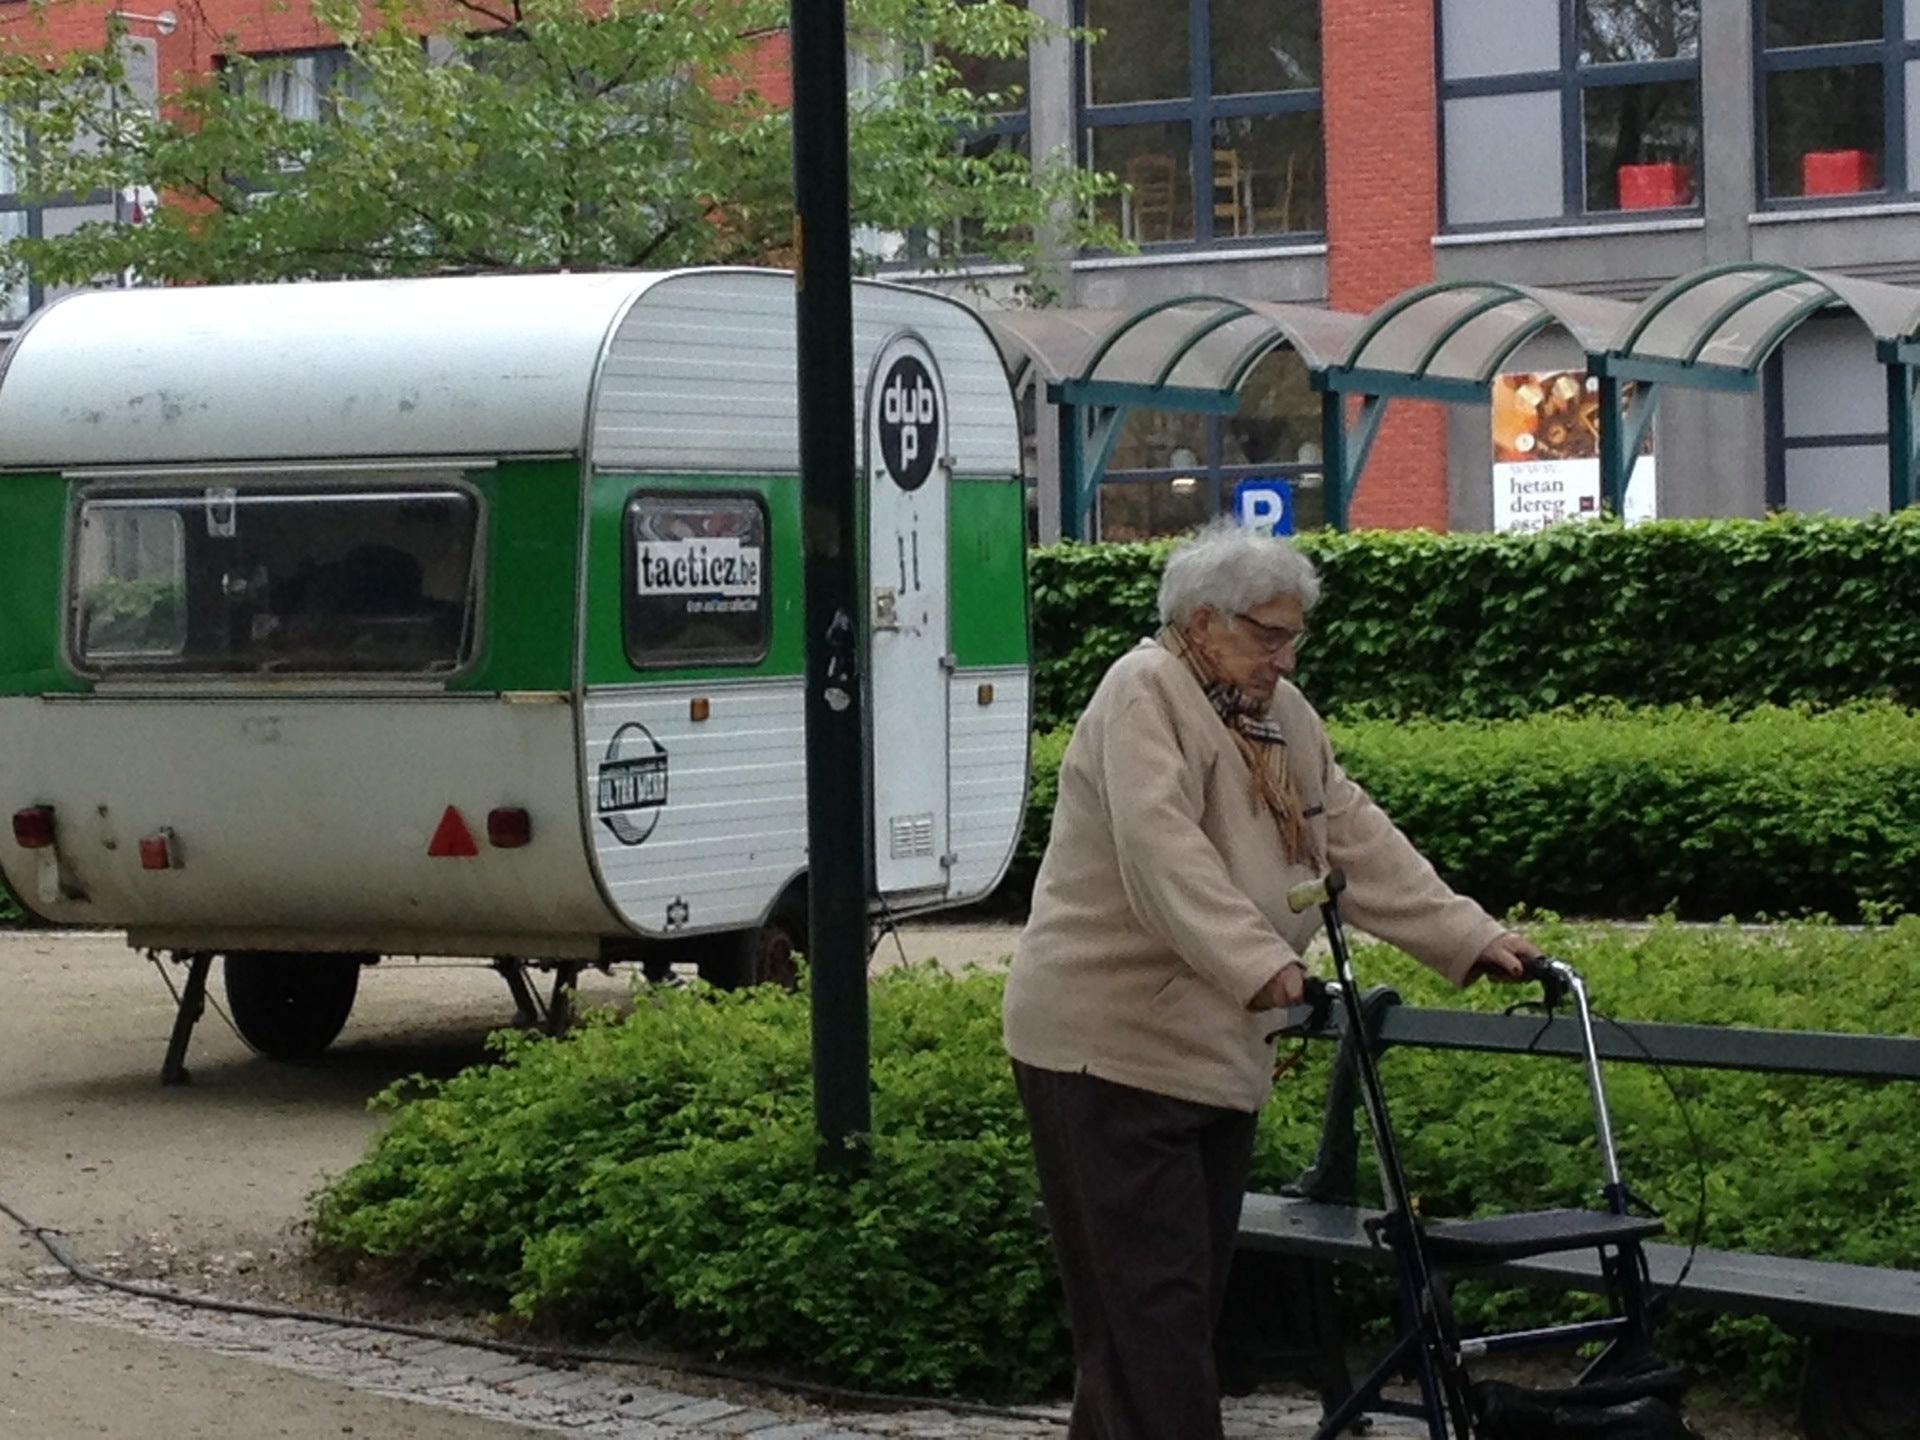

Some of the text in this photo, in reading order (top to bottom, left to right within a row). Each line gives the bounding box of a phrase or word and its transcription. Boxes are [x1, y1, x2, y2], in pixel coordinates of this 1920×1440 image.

[885, 373, 934, 424] dub
[1510, 477, 1564, 494] hetan
[1242, 488, 1283, 532] P
[1510, 496, 1565, 521] dereg
